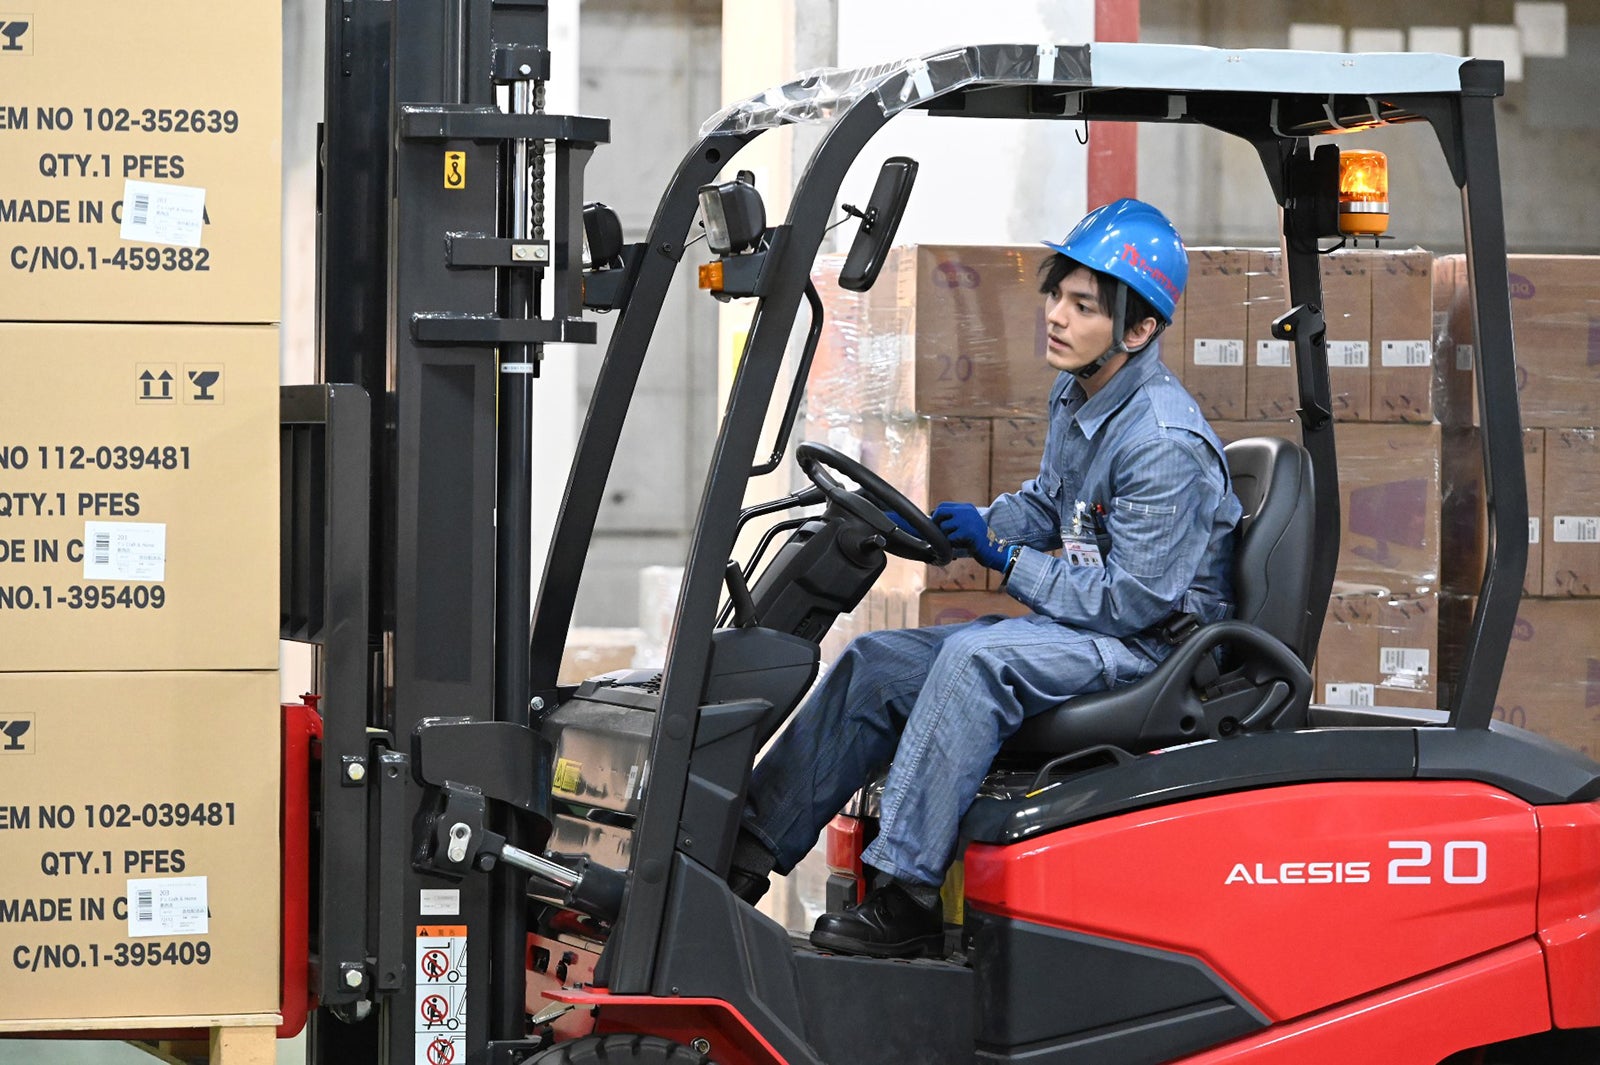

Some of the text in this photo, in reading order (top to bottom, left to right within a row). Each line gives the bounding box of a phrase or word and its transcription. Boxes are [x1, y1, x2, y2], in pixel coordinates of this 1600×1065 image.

[37, 107, 73, 130] NO
[83, 107, 239, 133] 102-352639
[39, 153, 185, 178] QTY.1 PFES
[0, 200, 70, 223] MADE
[78, 200, 103, 223] IN
[11, 246, 210, 272] C/NO.1-459382
[38, 446, 190, 469] 112-039481
[0, 493, 140, 517] QTY.1 PFES
[33, 539, 58, 562] IN
[0, 585, 166, 609] NO.1-395409
[38, 805, 74, 829] NO
[84, 803, 235, 828] 102-039481
[41, 849, 186, 876] QTY.1 PFES
[1224, 840, 1487, 884] ALESIS 20
[0, 898, 73, 922] MADE
[80, 897, 104, 921] IN
[13, 941, 211, 972] C/NO.1-395409
